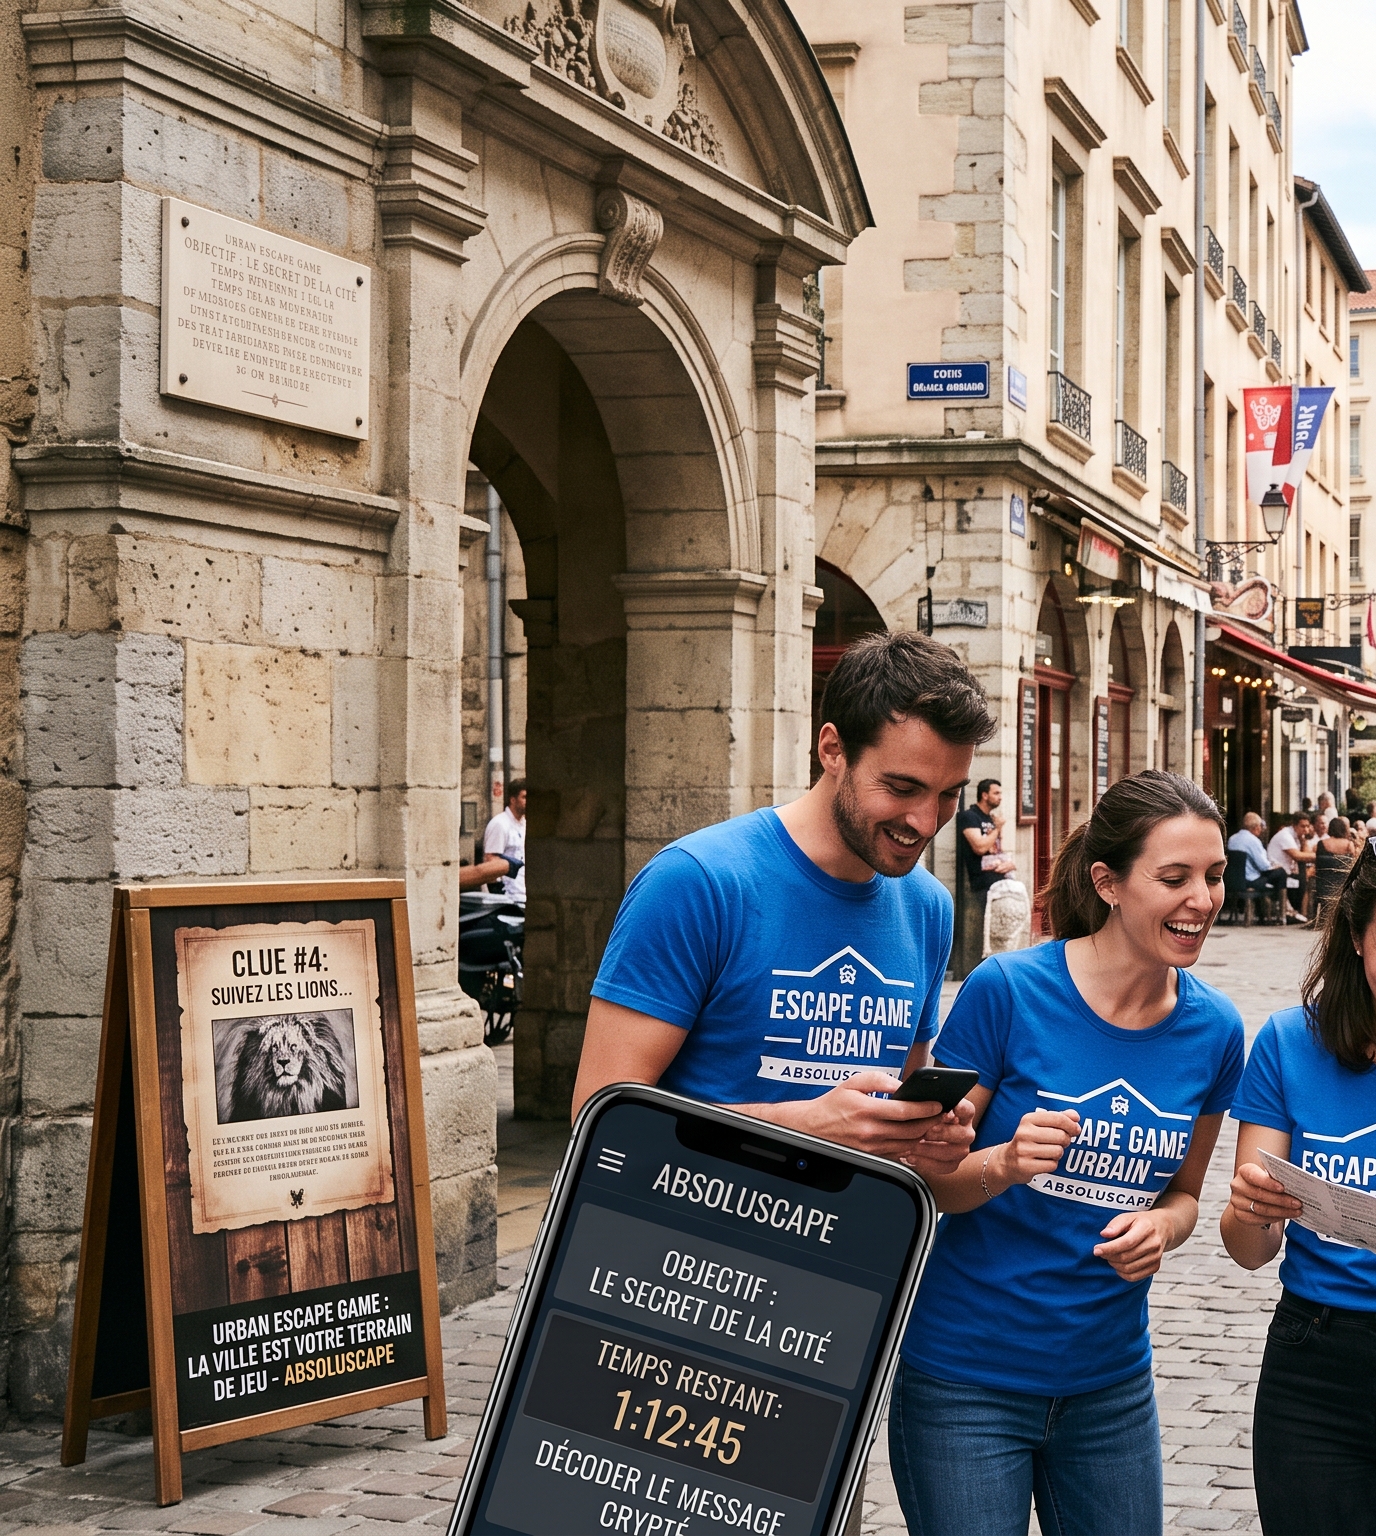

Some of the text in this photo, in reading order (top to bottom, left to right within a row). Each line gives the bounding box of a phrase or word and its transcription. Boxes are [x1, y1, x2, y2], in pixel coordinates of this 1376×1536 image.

[184, 236, 236, 263] OBJECTIF
[246, 256, 259, 271] LE
[262, 262, 301, 285] SECRET
[303, 275, 317, 290] DE
[319, 280, 332, 295] LA
[335, 286, 357, 303] CITÉ
[210, 261, 245, 282] TEMPS
[211, 278, 243, 297] TEMPS
[297, 258, 322, 276] GAME
[231, 945, 329, 978] CLUE #4:
[211, 979, 353, 1006] SUIVEZ LES LIONS...
[769, 988, 913, 1029] ESCAPE GAME
[806, 1026, 883, 1059] URBAIN
[1128, 1125, 1188, 1160] GAME
[1065, 1148, 1152, 1185] URBAIN
[651, 1162, 839, 1245] ABSOLUSCAPE
[1042, 1179, 1154, 1208] ABSOLUSCAPE
[661, 1249, 768, 1304] OBJECTIF
[212, 1314, 271, 1345] URBAN
[273, 1301, 334, 1334] ESCAPE
[337, 1292, 381, 1322] GAME
[589, 1266, 833, 1365] LE SECRET DE LA CITÉ
[187, 1312, 413, 1380] LA VILLE EST VOTRE TERRAIN
[213, 1377, 236, 1402] DE
[239, 1369, 268, 1397] JEU
[284, 1343, 395, 1387] ABSOLUSCAPE
[597, 1339, 784, 1420] TEMPS RESTANT:
[613, 1388, 747, 1466] 1:12:45
[535, 1439, 786, 1536] DÉCODER LE MESSAGE
